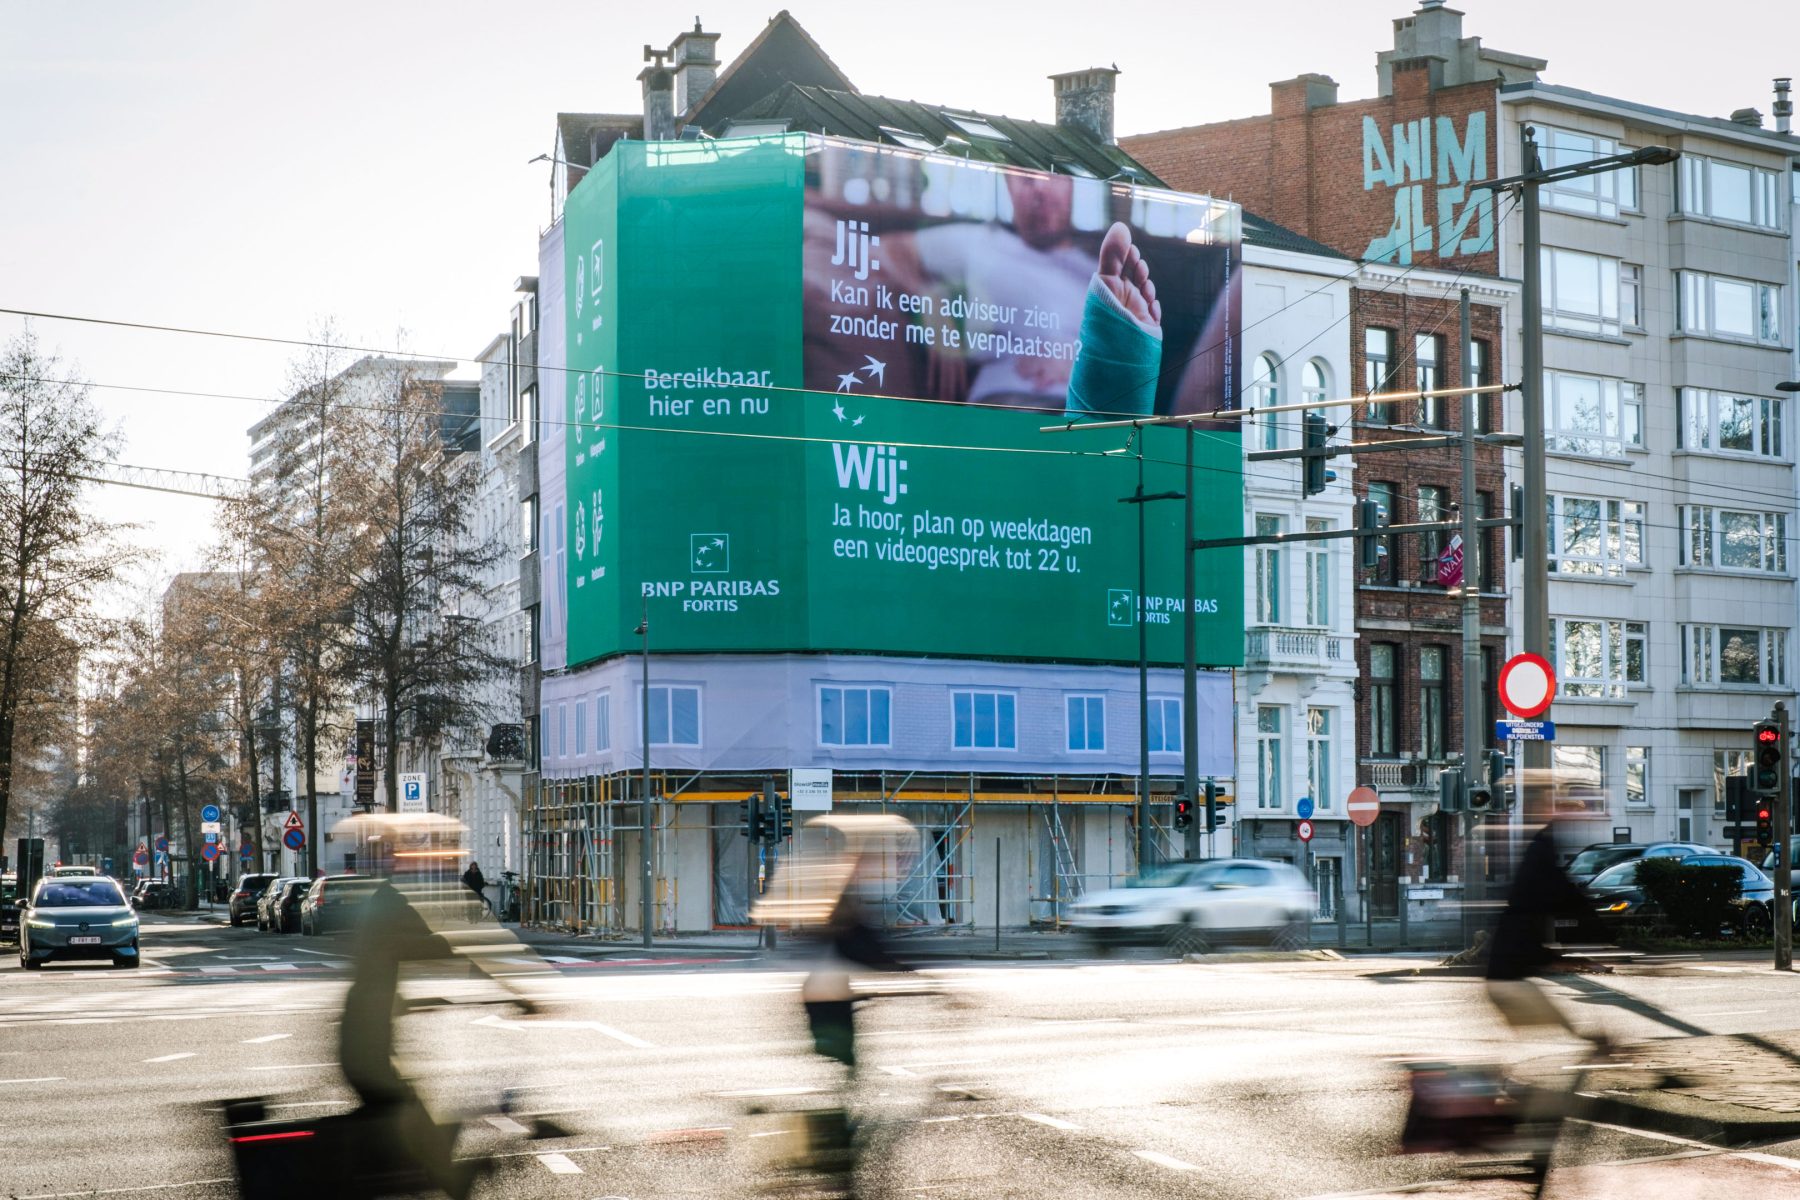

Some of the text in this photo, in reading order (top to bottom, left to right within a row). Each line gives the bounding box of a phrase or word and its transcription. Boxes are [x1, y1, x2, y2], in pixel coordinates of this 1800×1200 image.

[832, 220, 880, 280] Jij:
[832, 280, 1060, 330] Kan ik een adviseur zien
[830, 314, 1082, 361] zonder me te verplaatsen?
[644, 367, 773, 390] Bereikbaar,
[650, 395, 769, 416] hier en nu
[832, 442, 908, 505] Wij:
[832, 503, 1091, 549] Ja hoor, plan op weekdagen
[834, 537, 1080, 573] een videogesprek tot 22 u.
[641, 580, 780, 597] BNP PARIBAS
[683, 600, 738, 612] FORTIS
